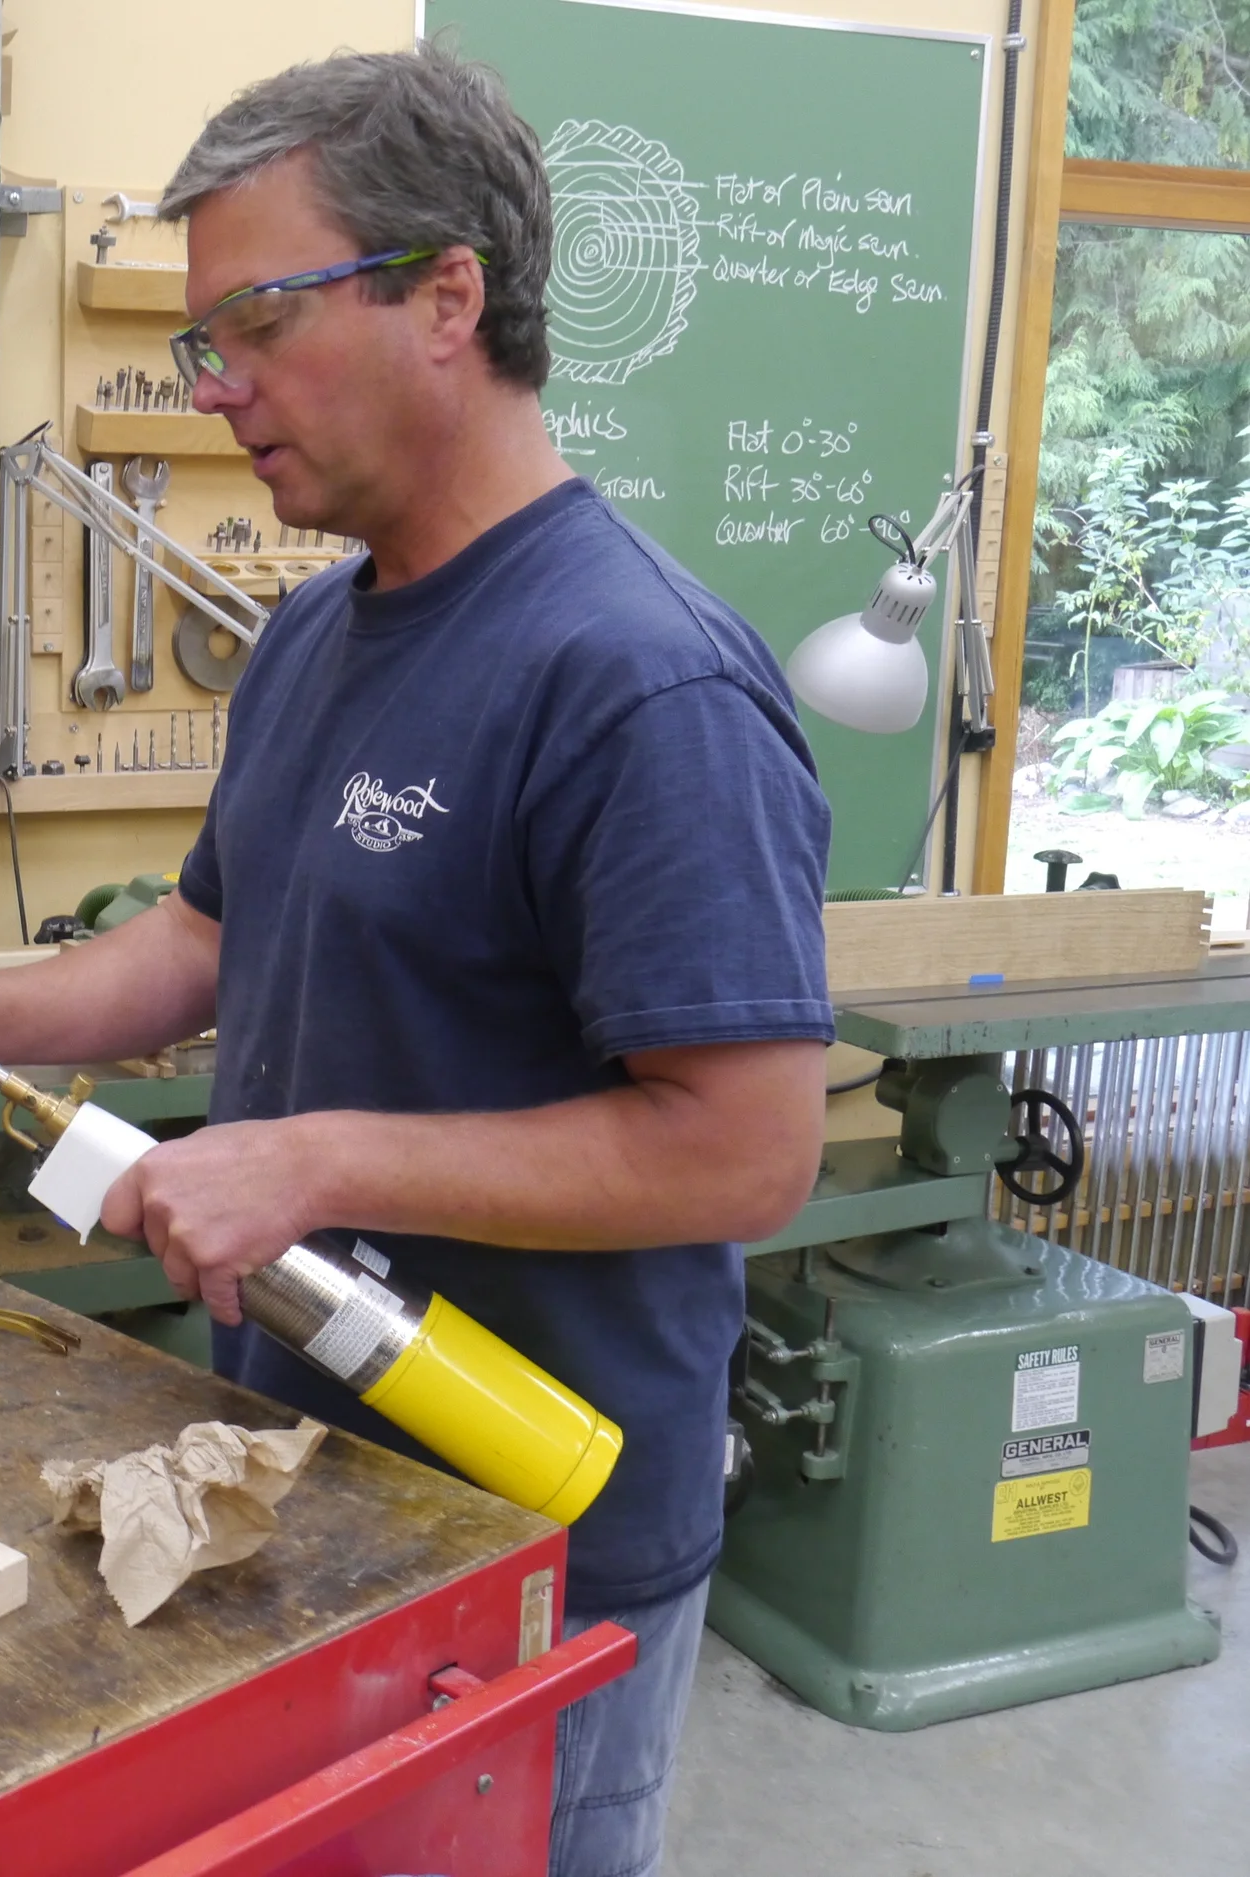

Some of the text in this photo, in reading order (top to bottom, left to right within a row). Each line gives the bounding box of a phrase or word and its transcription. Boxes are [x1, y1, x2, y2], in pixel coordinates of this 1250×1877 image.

[715, 173, 764, 205] Flat
[763, 173, 797, 206] or
[802, 171, 859, 213] Plain
[716, 213, 766, 243] Rift
[767, 219, 797, 248] or
[713, 254, 790, 288] Quarter
[794, 269, 821, 288] or
[829, 269, 878, 313] Edge
[724, 464, 779, 502] Rift
[715, 511, 805, 545] Quarter
[333, 771, 450, 829] Rosewood
[356, 833, 391, 849] STUDIO
[1017, 1346, 1078, 1369] SAFETY RULES
[1005, 1433, 1086, 1457] GENERAL
[1016, 1491, 1068, 1509] ALLWEST
